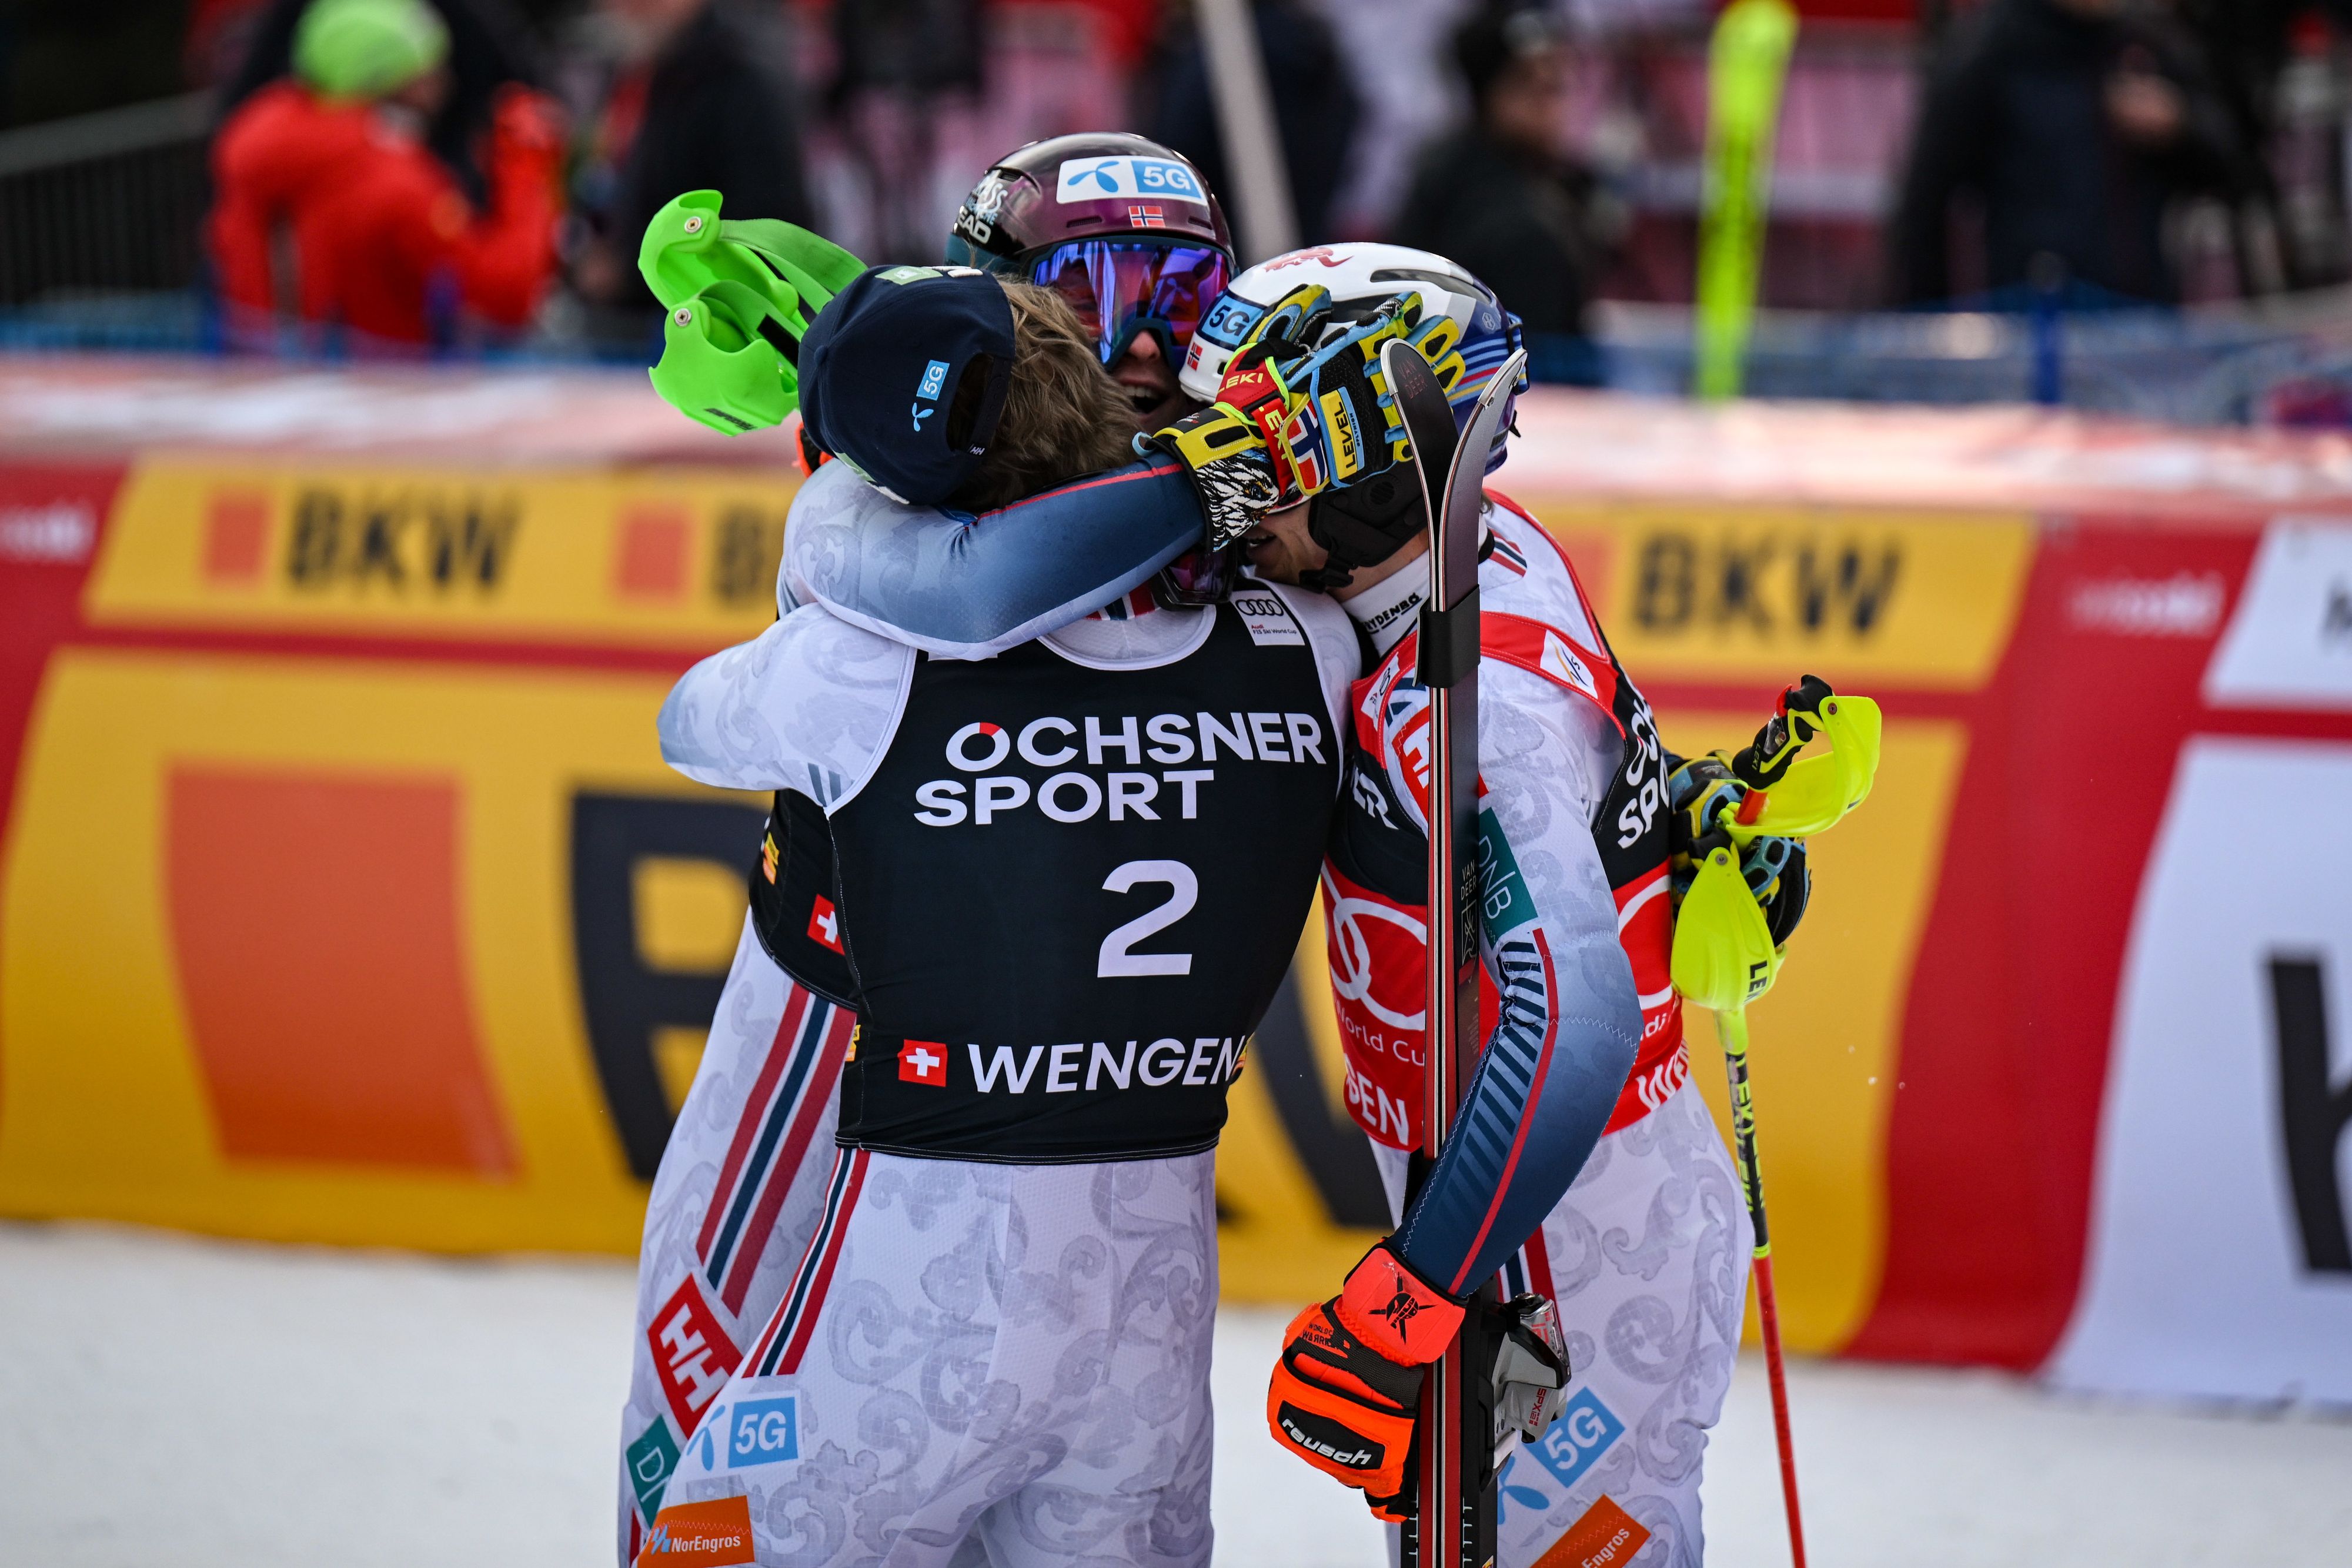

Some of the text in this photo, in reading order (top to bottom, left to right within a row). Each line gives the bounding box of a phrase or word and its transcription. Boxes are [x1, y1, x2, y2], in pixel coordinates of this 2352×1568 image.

[1143, 166, 1191, 190] 5G
[1209, 305, 1250, 336] 5G
[923, 366, 944, 395] 5G
[1218, 372, 1264, 393] EKI
[1334, 402, 1357, 469] LEVEL
[285, 490, 517, 594] BKW
[1633, 530, 1903, 634] BKW
[946, 712, 1327, 771] OCHSNER
[914, 770, 1214, 827] SPORT
[1461, 875, 1477, 901] DEER
[1462, 859, 1475, 882] VAN
[1097, 860, 1198, 978] 2
[967, 1035, 1245, 1094] WENGEN
[1392, 1039, 1425, 1066] Cu
[660, 1303, 731, 1412] HH
[735, 1412, 787, 1455] 5G
[1282, 1418, 1372, 1465] reusch
[1544, 1406, 1608, 1470] 5G
[671, 1536, 741, 1553] NorEngros
